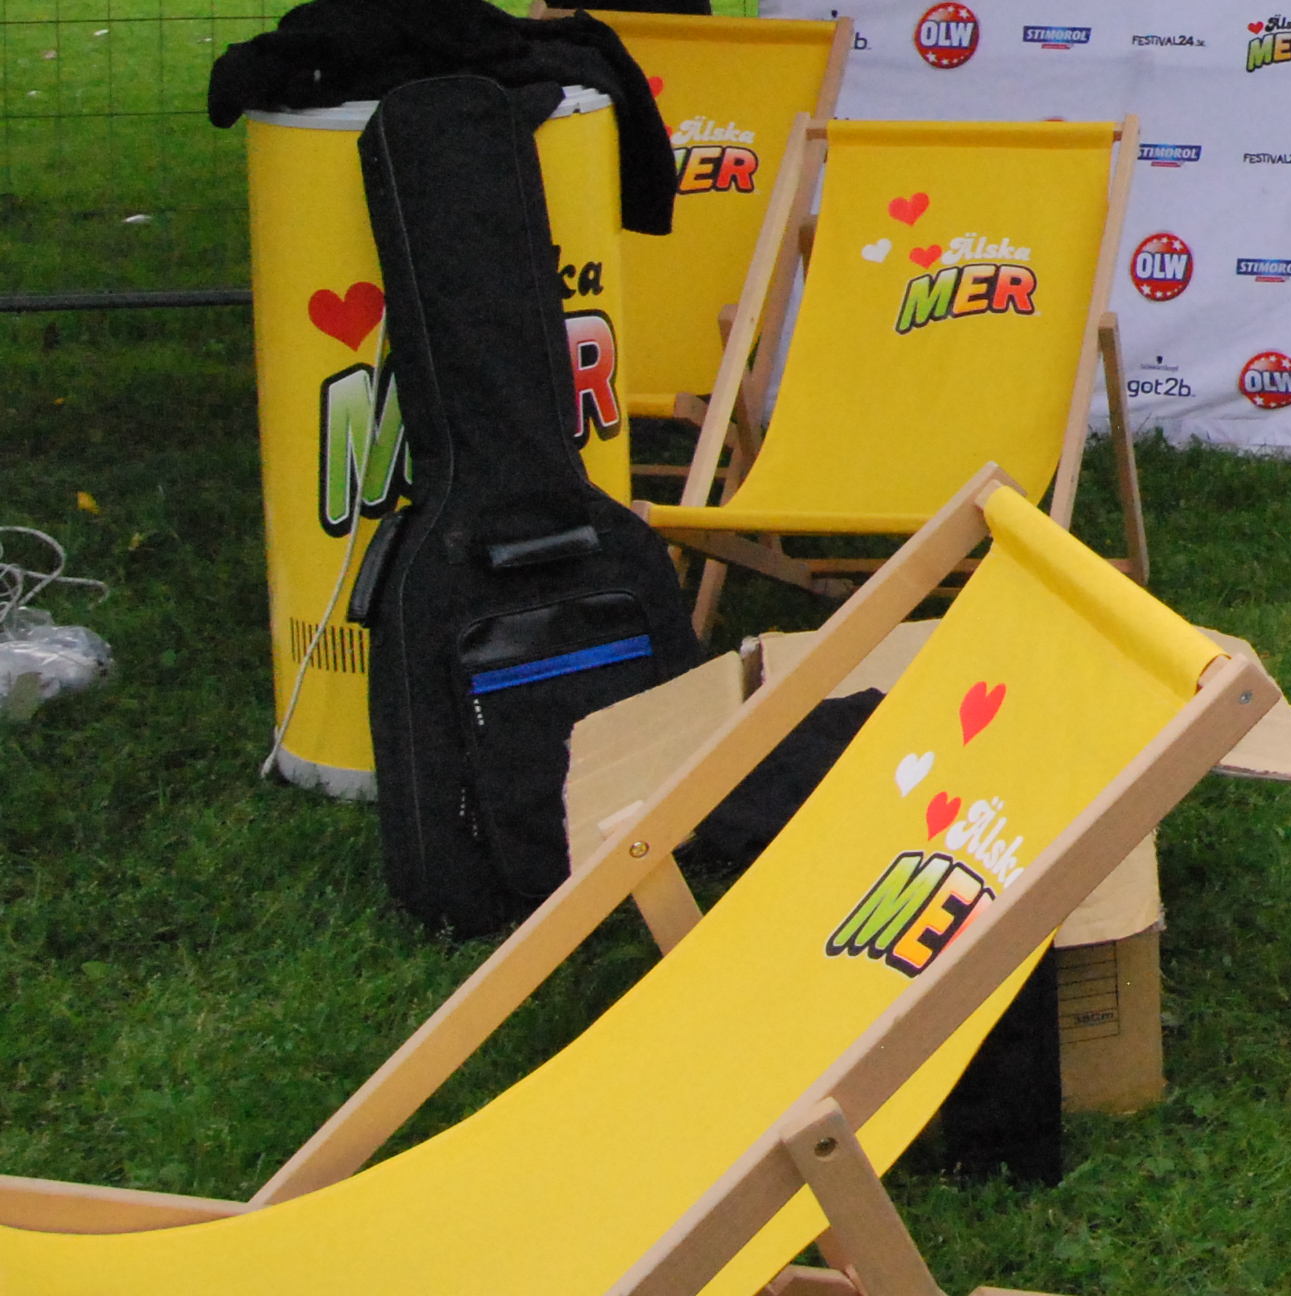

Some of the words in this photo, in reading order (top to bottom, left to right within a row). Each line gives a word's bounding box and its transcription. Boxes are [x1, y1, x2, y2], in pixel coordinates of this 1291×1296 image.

[919, 21, 974, 48] OLW
[1025, 28, 1090, 43] STIMOROL
[671, 115, 756, 145] Älska
[1138, 146, 1198, 160] TIMOROL
[941, 232, 1031, 265] Älska
[1136, 253, 1188, 280] OLW
[895, 263, 1038, 336] MER
[1127, 377, 1192, 398] got2b
[319, 308, 622, 538] MR
[825, 850, 997, 979] ME
